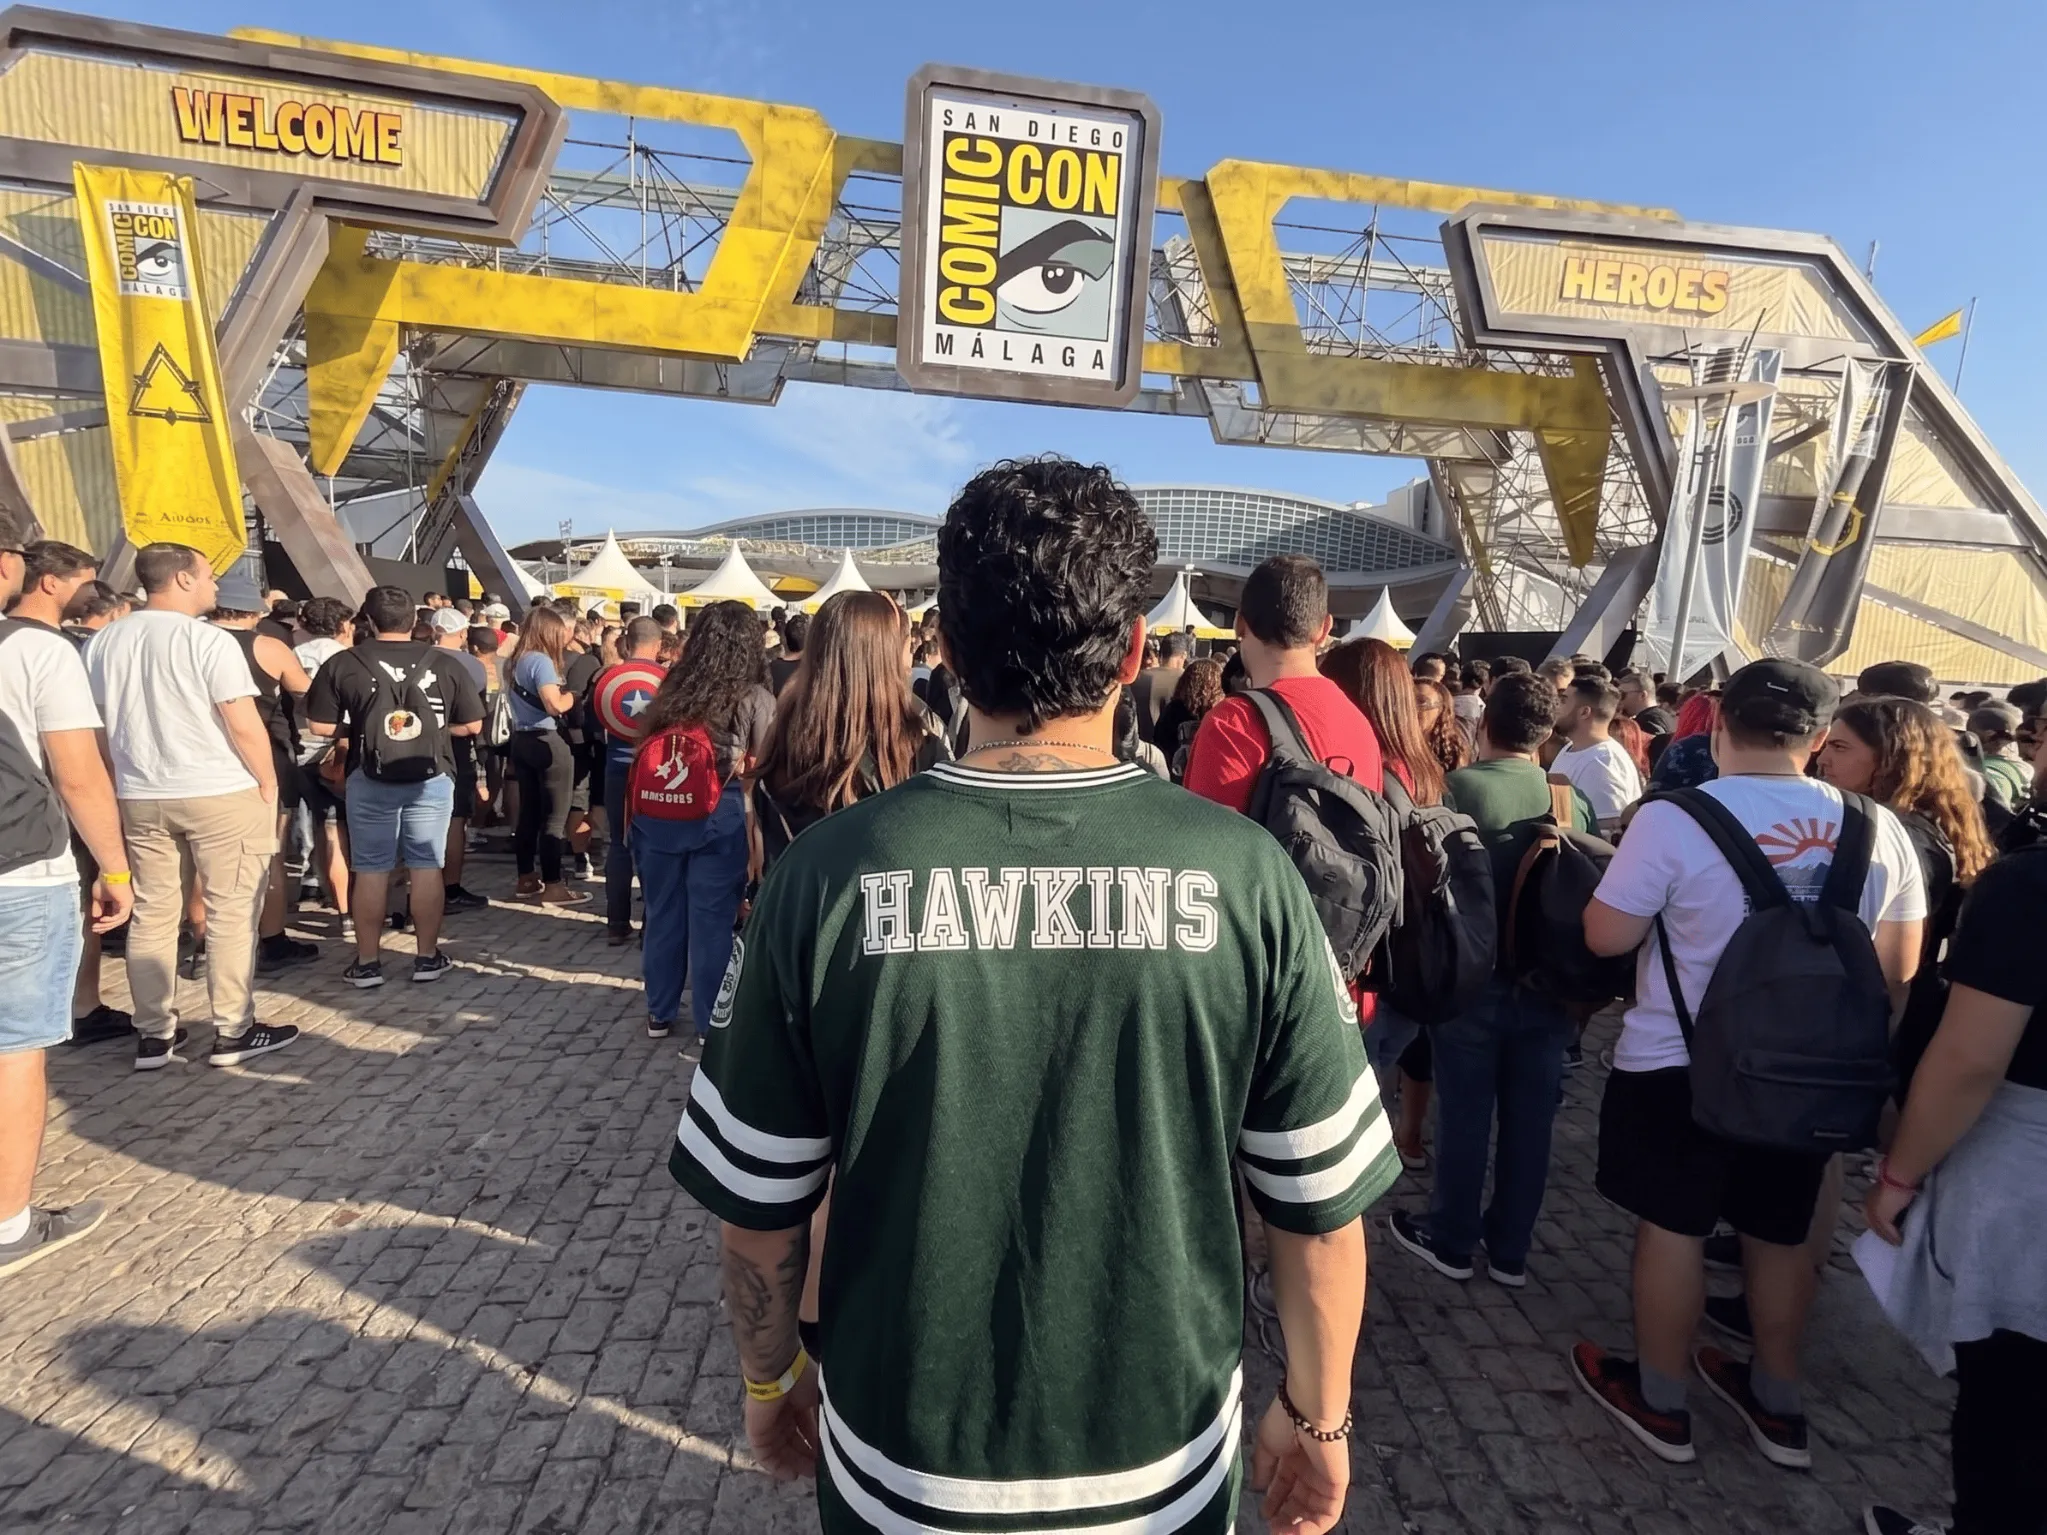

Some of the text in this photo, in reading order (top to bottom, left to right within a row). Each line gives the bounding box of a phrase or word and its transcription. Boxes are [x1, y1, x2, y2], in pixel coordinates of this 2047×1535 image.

[172, 86, 403, 166] WELCOME
[943, 108, 1123, 149] SAN DIEGO
[1007, 143, 1119, 216] CON
[112, 213, 138, 280] COMIC
[133, 215, 177, 240] CON
[938, 137, 1003, 325] COMIC
[1561, 256, 1730, 315] HEROES
[935, 332, 1104, 370] MÁLAGA
[860, 867, 1219, 955] HAWKINS
